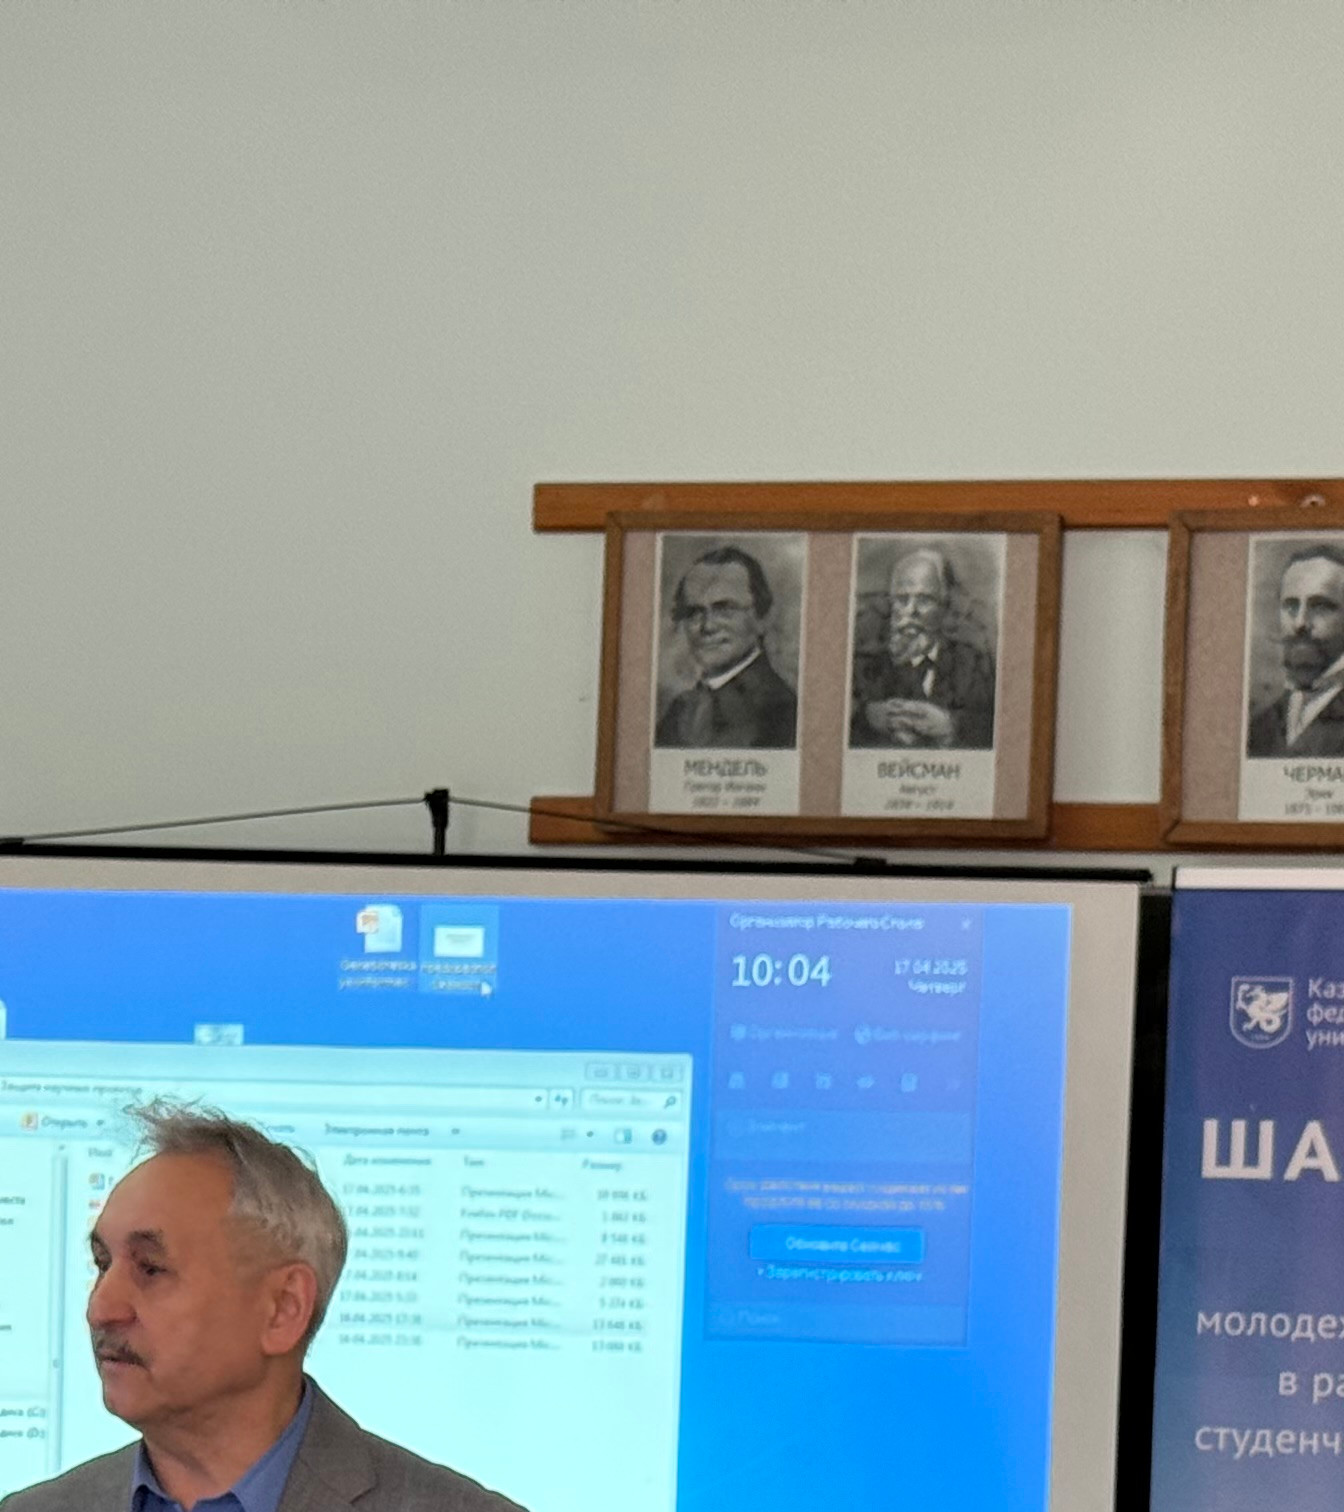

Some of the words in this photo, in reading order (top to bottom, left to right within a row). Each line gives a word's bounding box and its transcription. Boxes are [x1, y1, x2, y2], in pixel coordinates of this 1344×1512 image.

[683, 759, 768, 777] МЕНДЕЛЬ
[877, 759, 961, 779] ВЕЙСМАН
[731, 953, 833, 987] 10:04
[1278, 1371, 1297, 1397] в
